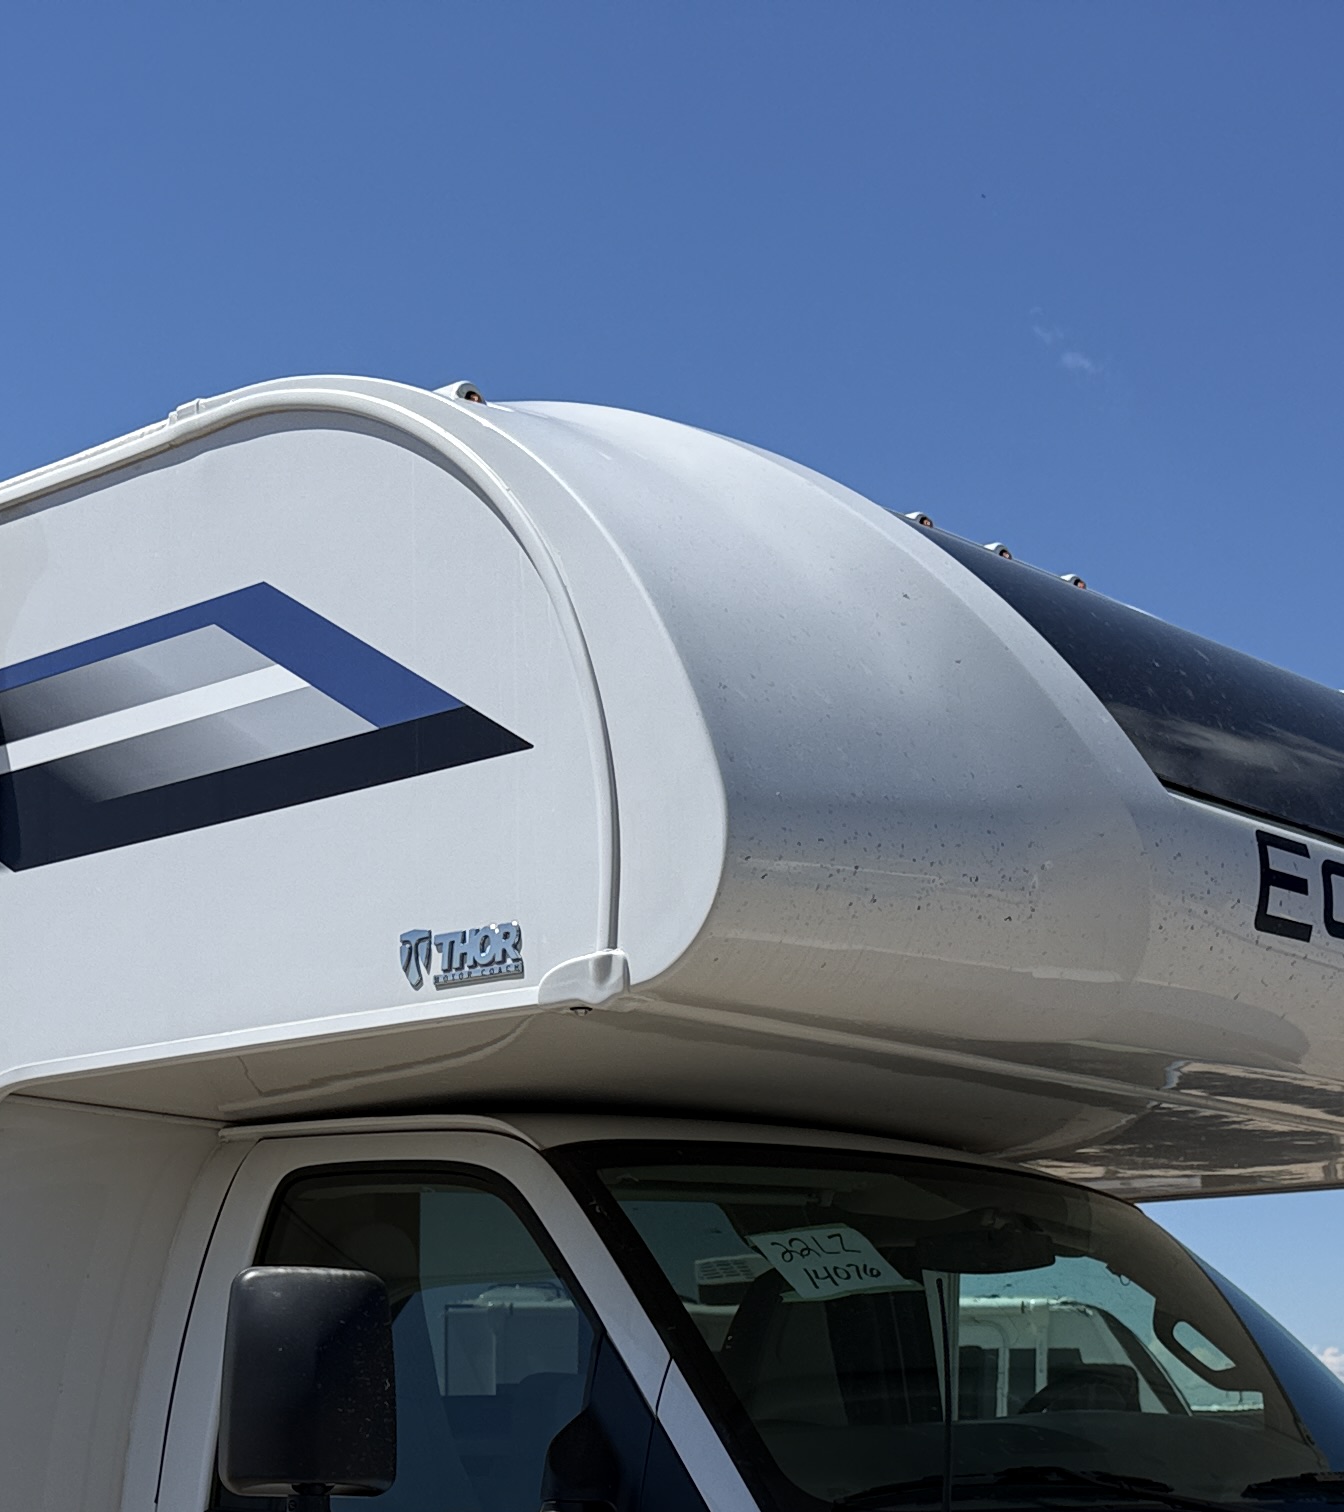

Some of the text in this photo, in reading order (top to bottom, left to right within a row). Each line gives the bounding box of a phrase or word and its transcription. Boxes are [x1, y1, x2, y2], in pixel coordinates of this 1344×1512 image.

[434, 920, 523, 973] THOR
[434, 964, 520, 983] MOTOR COACH
[803, 1264, 882, 1289] 14076
